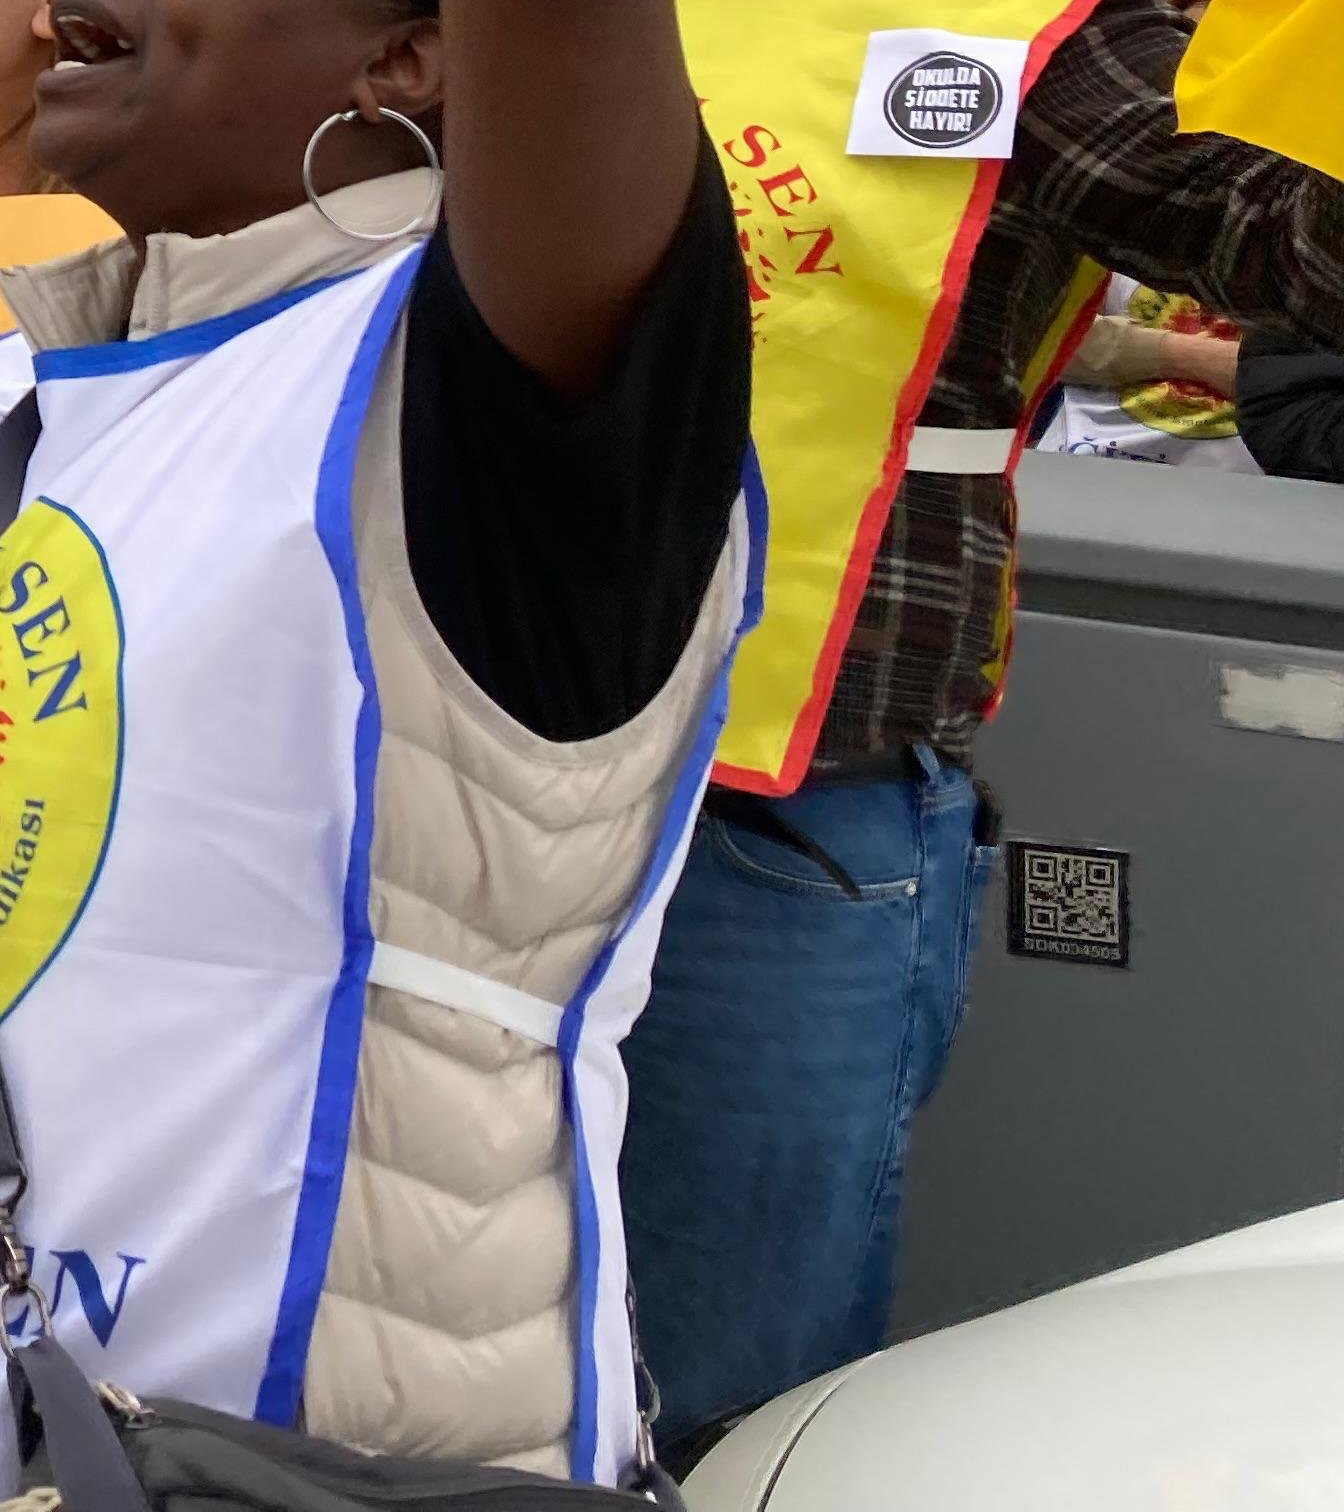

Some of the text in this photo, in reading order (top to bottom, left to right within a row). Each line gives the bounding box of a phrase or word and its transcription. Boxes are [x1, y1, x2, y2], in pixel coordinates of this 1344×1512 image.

[912, 67, 981, 87] OKULDA
[909, 110, 973, 132] HAYIR!
[721, 124, 845, 278] SEN
